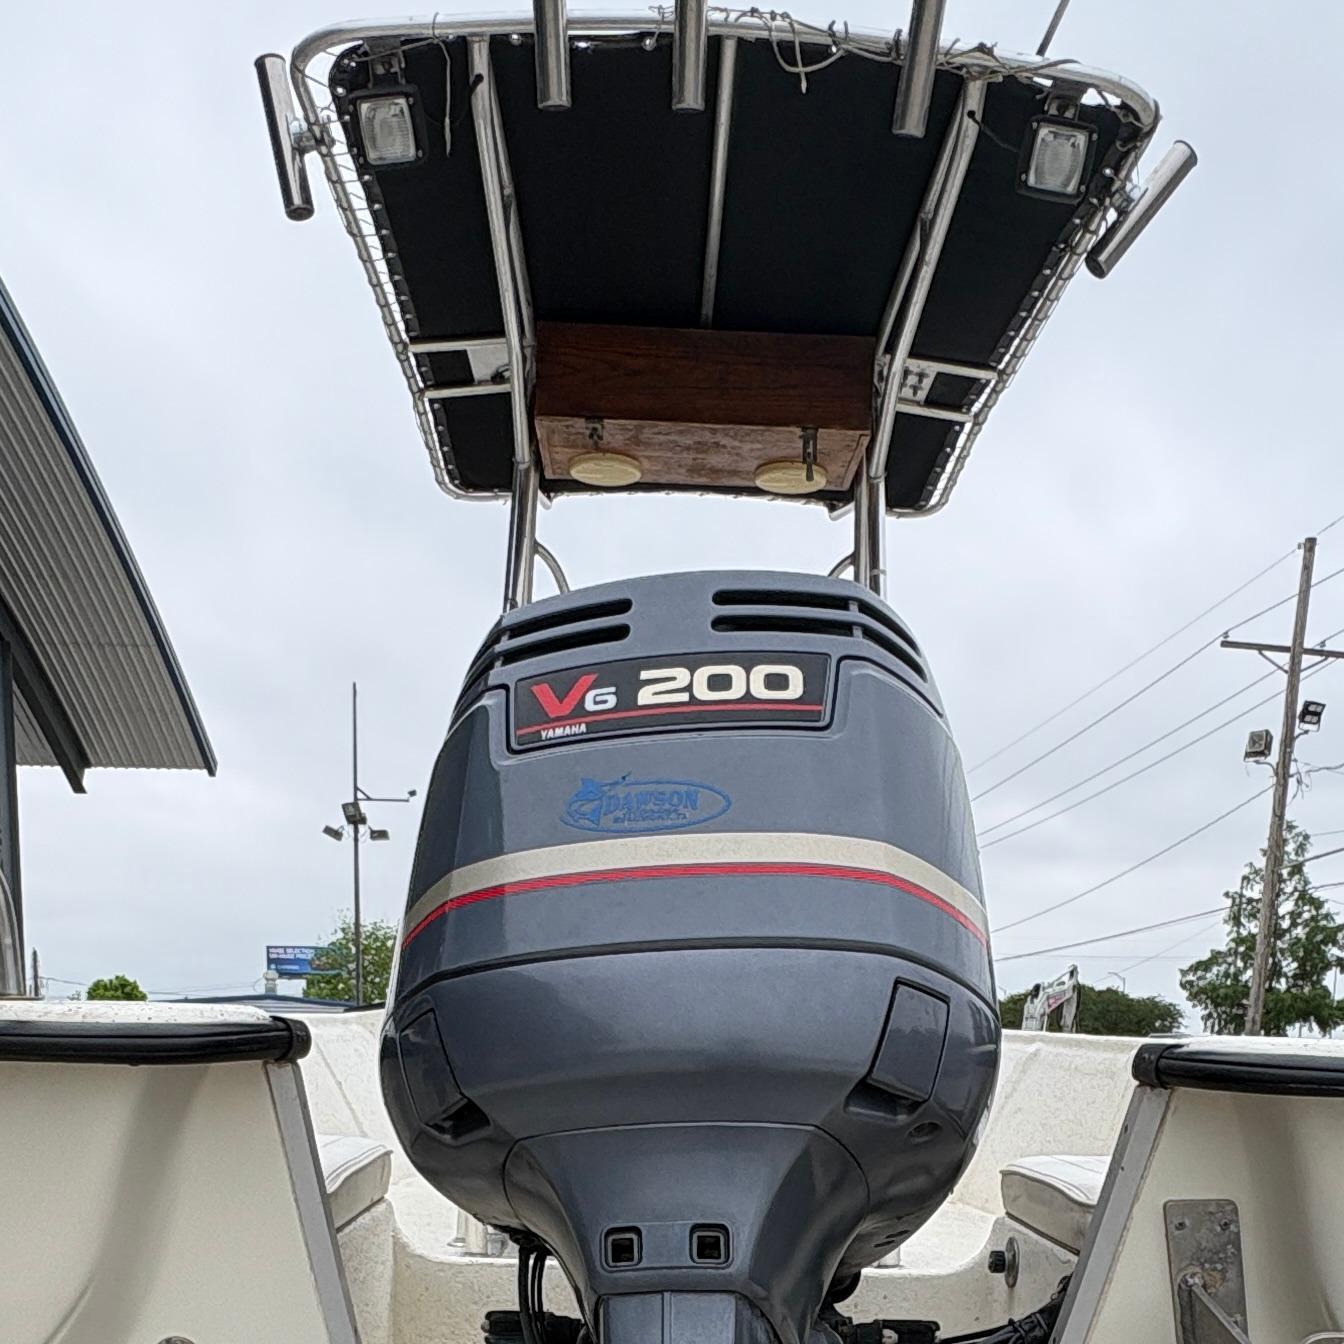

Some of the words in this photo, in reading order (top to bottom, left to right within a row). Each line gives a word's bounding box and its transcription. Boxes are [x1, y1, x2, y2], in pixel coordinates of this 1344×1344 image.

[637, 664, 804, 706] 200
[540, 723, 587, 740] YAMAHA
[604, 789, 700, 817] DAWSON
